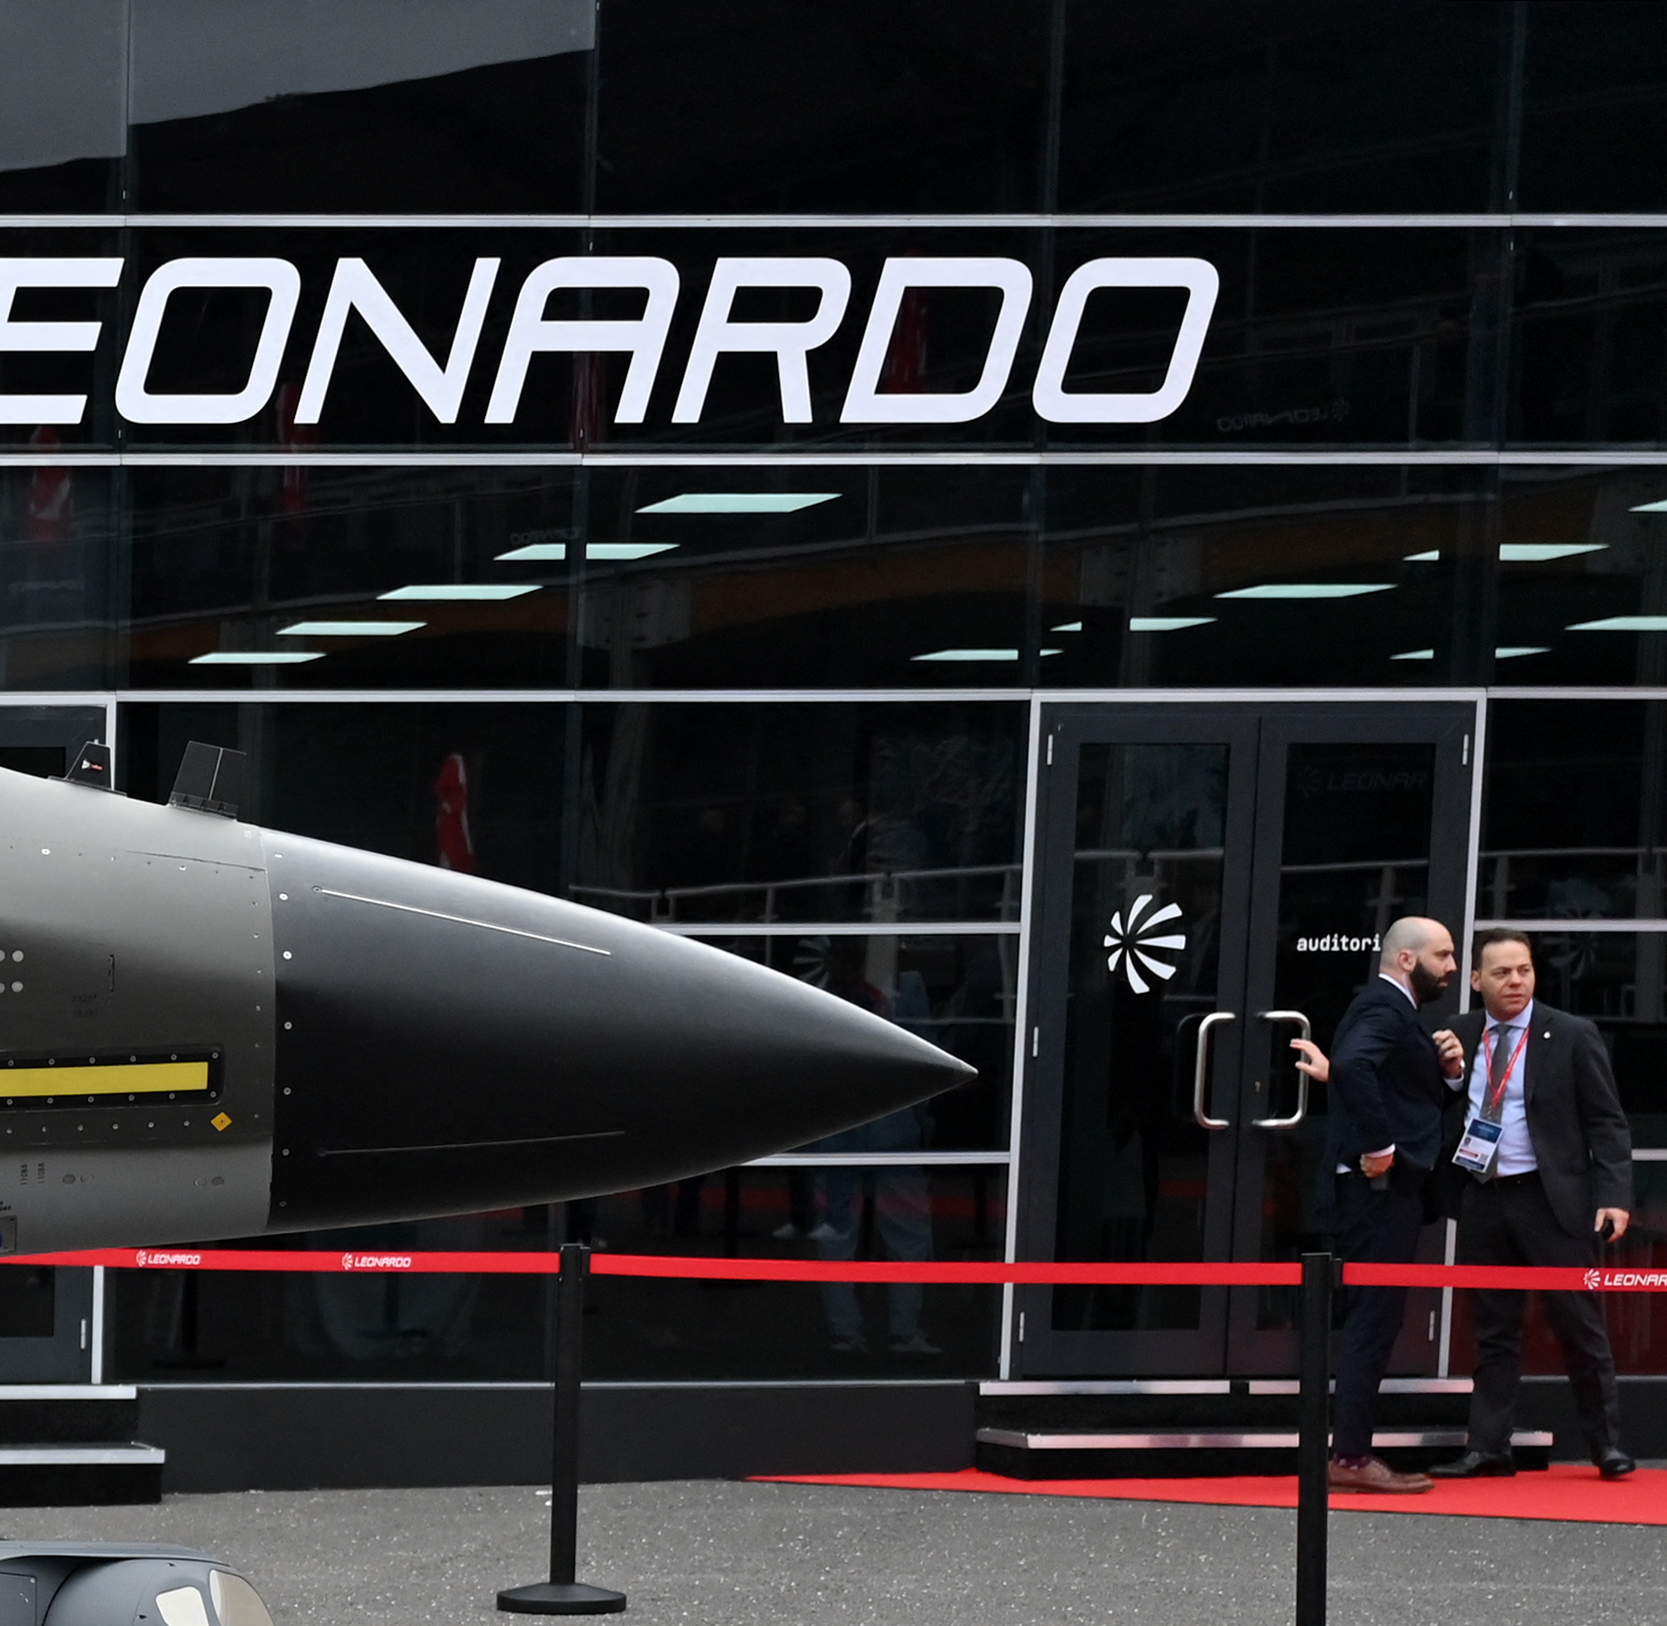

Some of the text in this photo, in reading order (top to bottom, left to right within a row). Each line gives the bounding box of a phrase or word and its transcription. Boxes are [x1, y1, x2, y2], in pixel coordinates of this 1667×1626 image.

[1296, 932, 1382, 952] auditori
[147, 1254, 201, 1265] LEONARDO
[354, 1257, 412, 1268] LEONARDO
[1603, 1273, 1667, 1287] LEONAR
